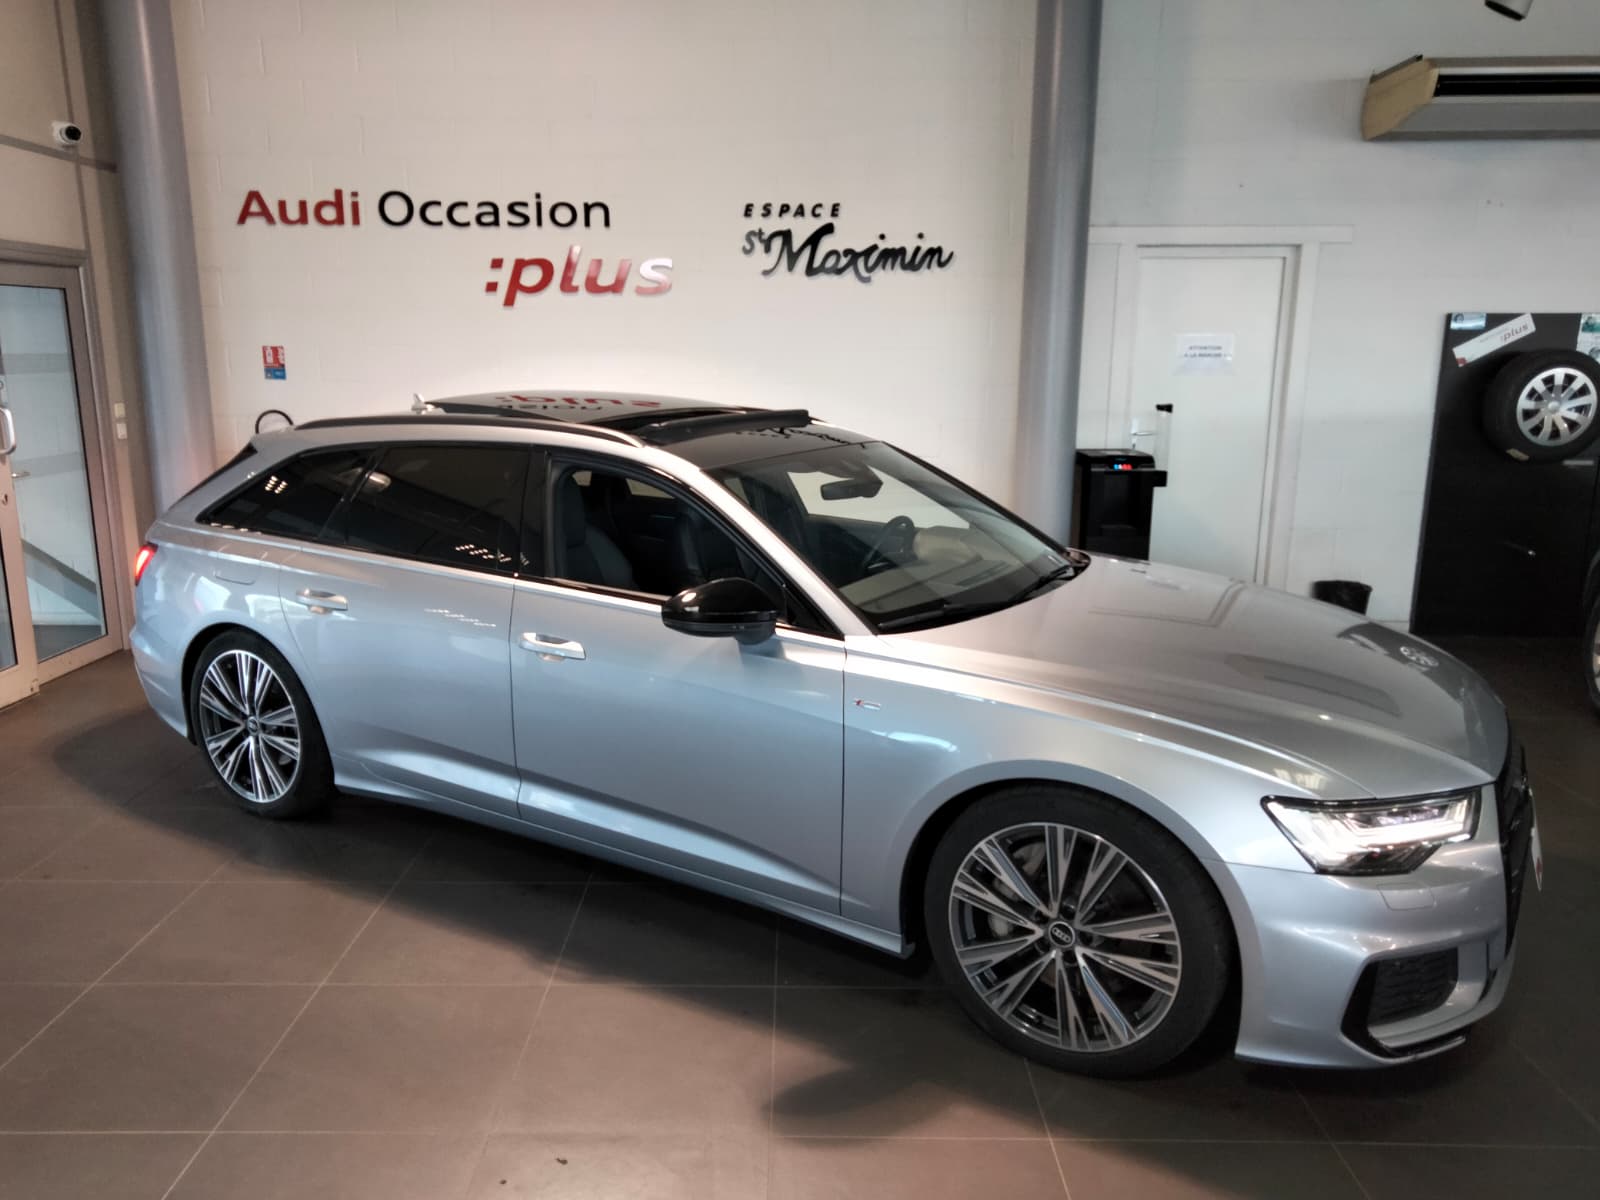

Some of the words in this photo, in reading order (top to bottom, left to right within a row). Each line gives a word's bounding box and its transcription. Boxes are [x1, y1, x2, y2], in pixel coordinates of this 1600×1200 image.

[236, 188, 361, 226] Audi
[378, 190, 612, 228] Occasion
[743, 203, 841, 218] ESPACE
[484, 245, 673, 307] :plus
